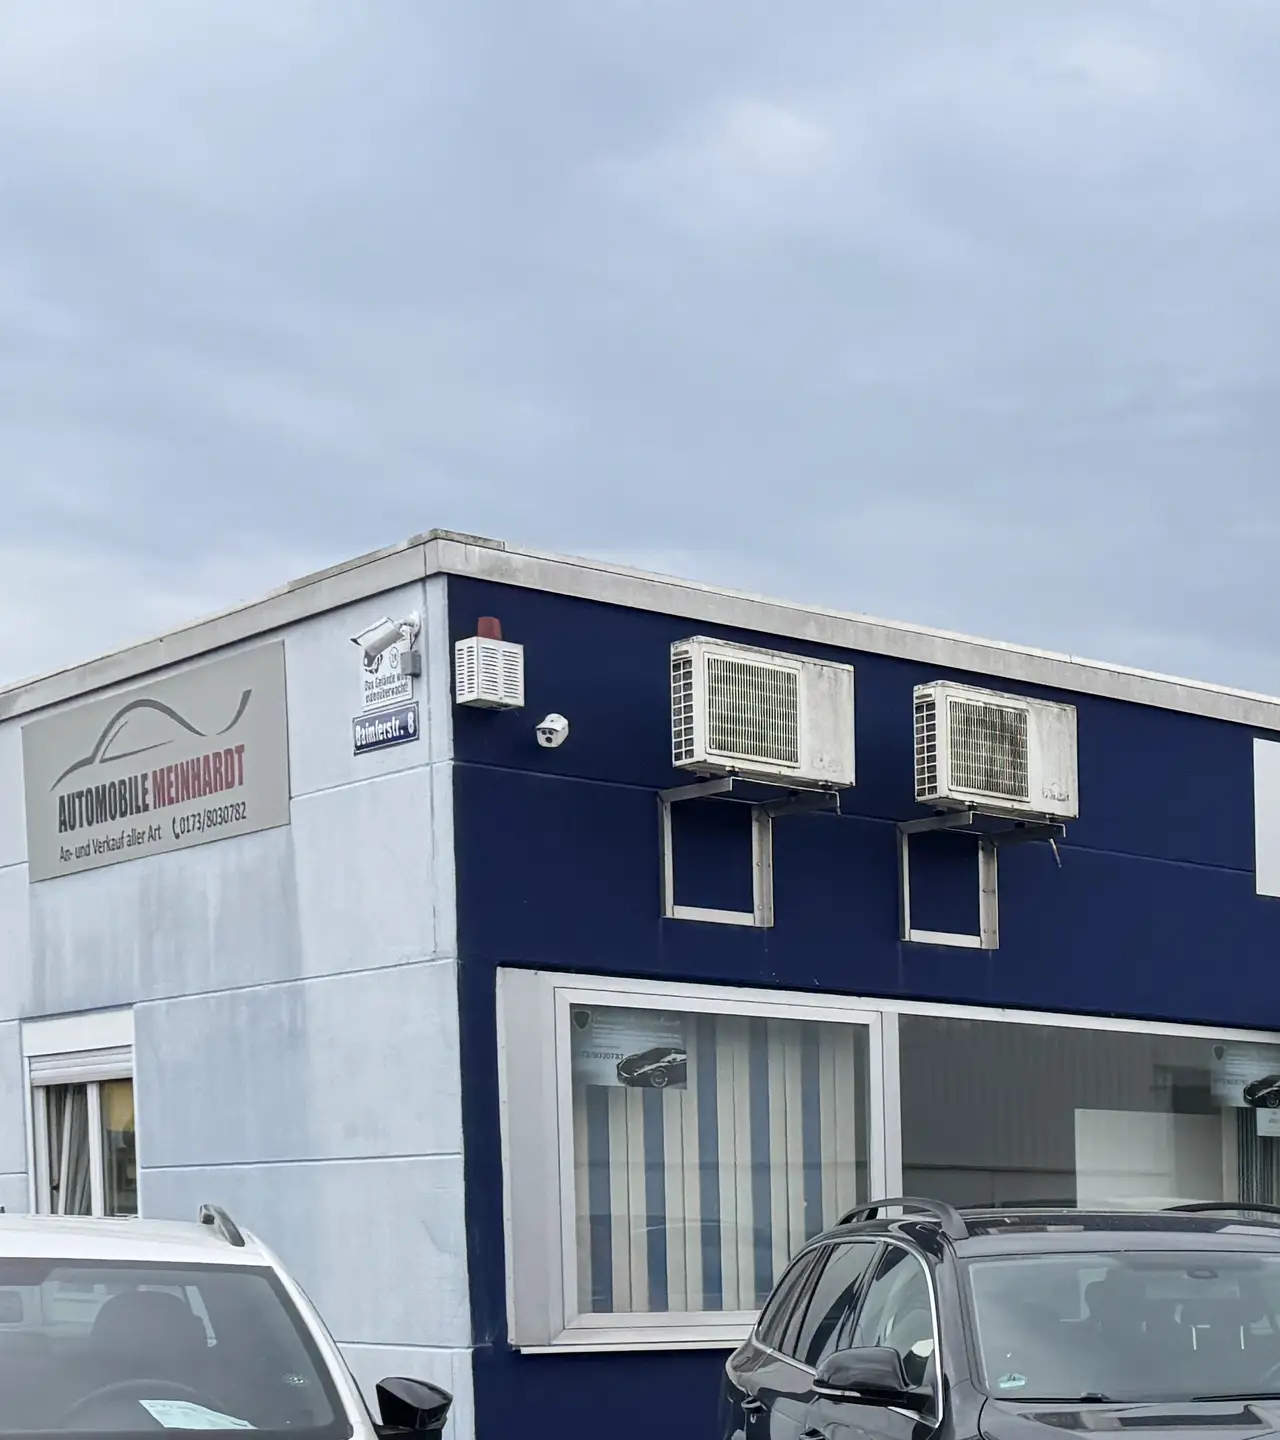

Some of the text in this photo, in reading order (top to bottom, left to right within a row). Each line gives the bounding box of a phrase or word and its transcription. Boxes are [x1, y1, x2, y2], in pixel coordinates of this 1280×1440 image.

[355, 711, 415, 746] Daimlerstr. 8
[58, 744, 245, 833] AUTOMOBILE MEINHARDT
[60, 801, 247, 862] An- und Verkauf aller Art 0173/8030782
